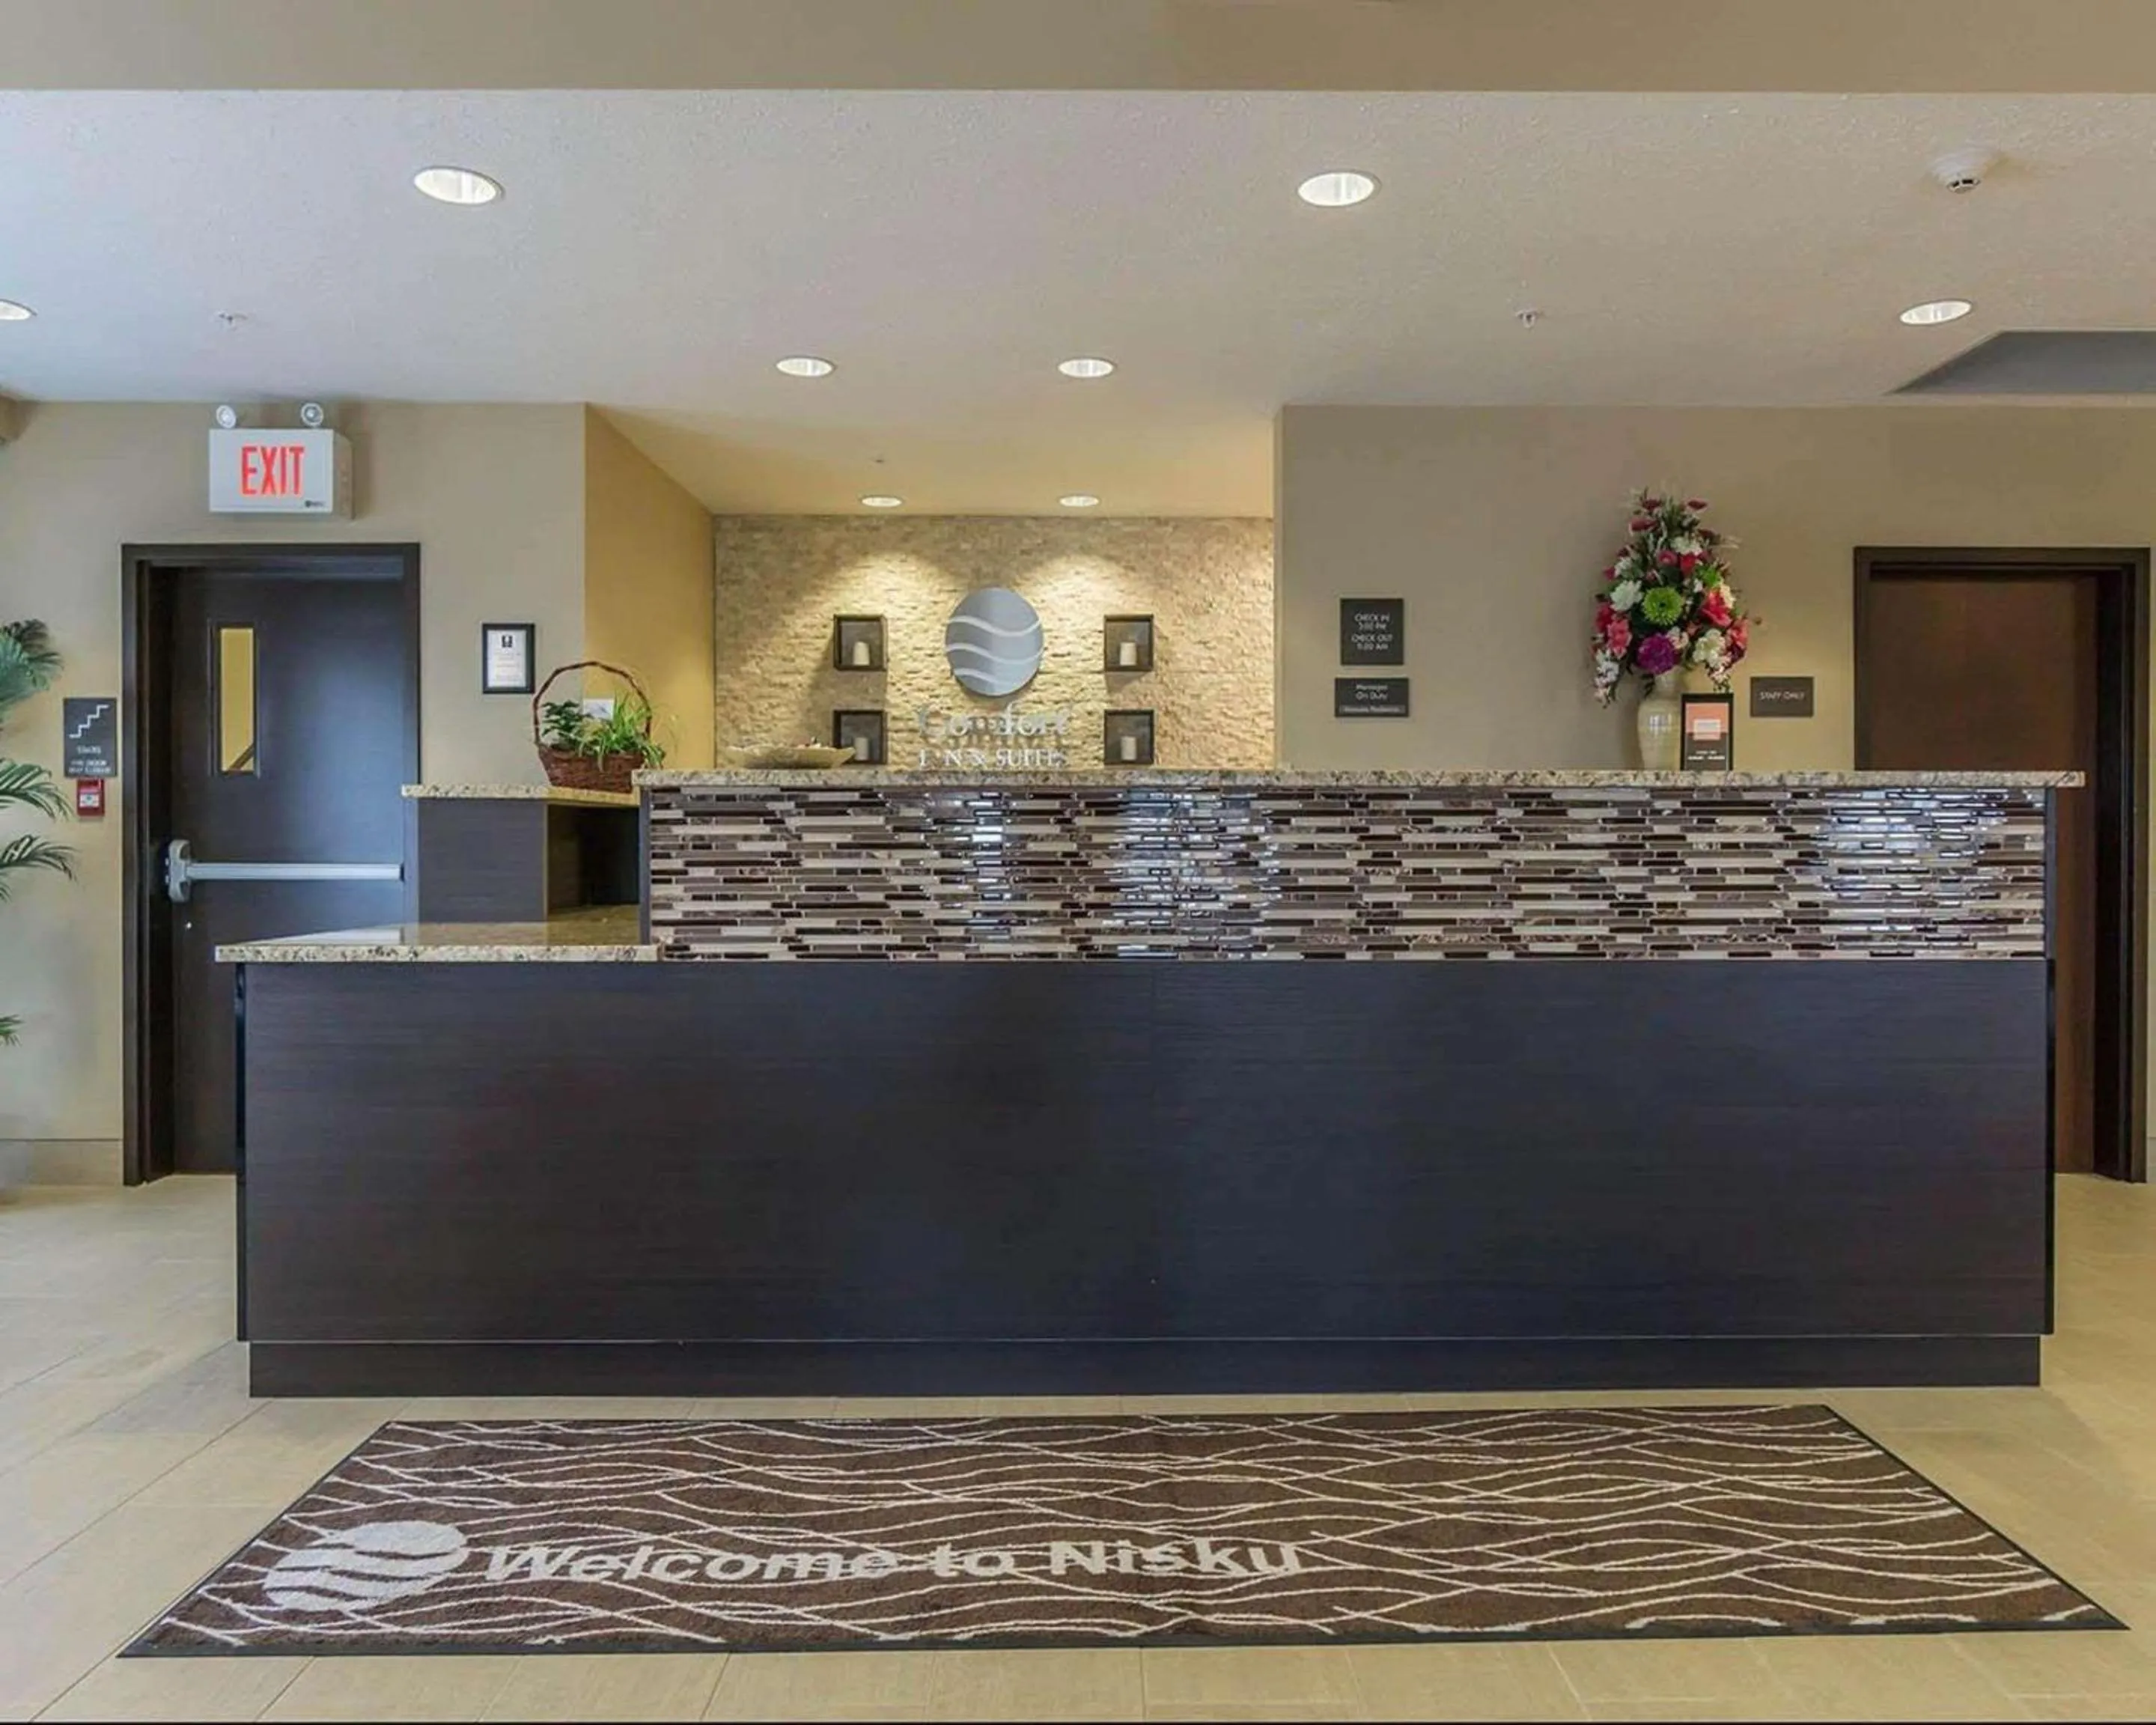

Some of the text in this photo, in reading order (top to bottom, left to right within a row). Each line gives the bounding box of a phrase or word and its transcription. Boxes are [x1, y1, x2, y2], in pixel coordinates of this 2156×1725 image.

[241, 445, 305, 496] EXIT
[484, 1538, 1301, 1582] Welcome to Nisku
